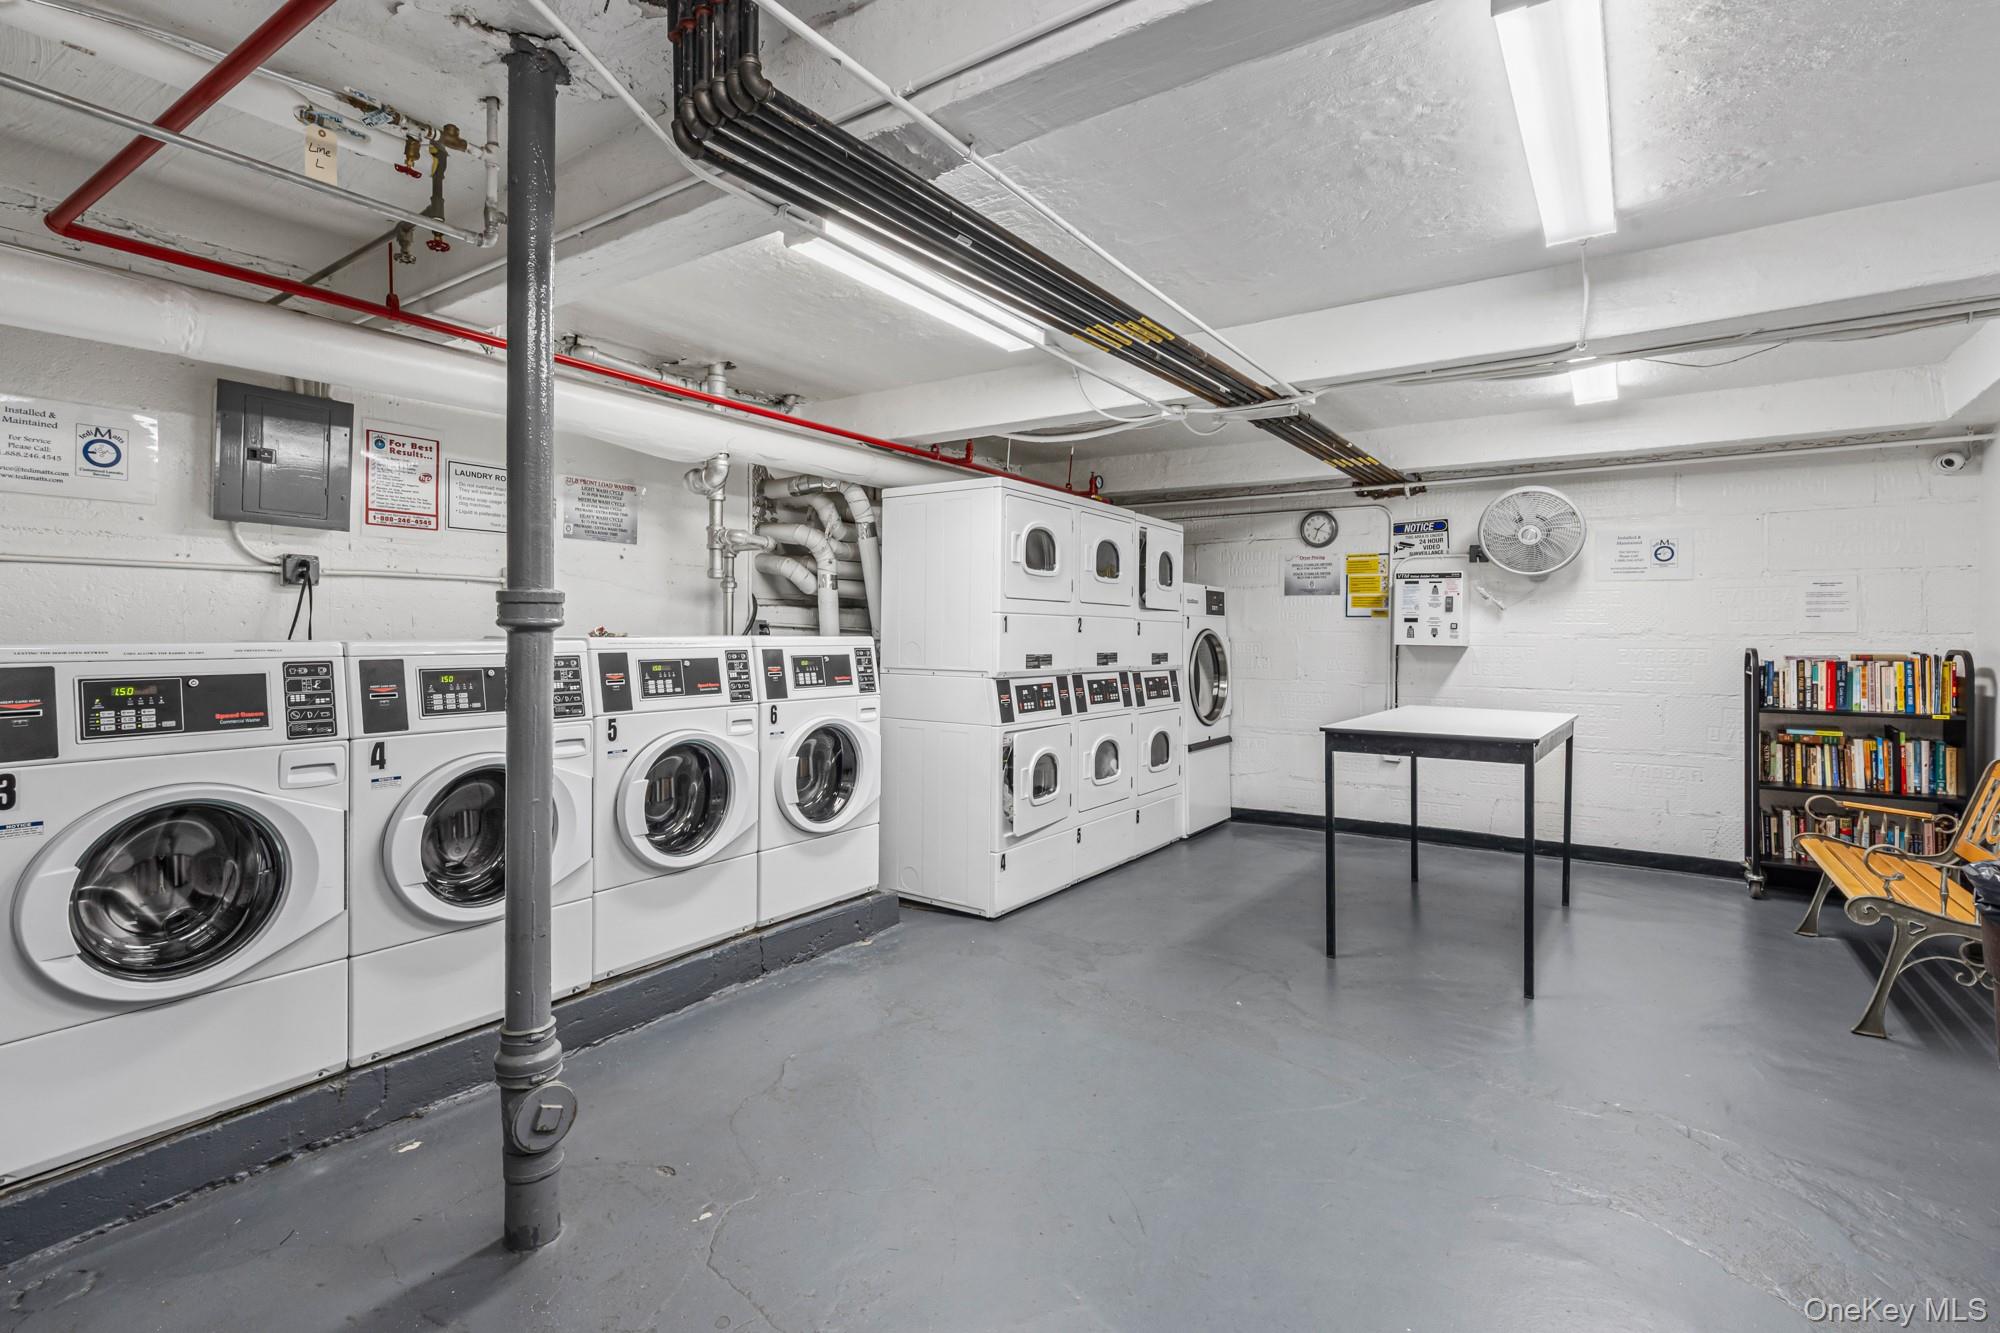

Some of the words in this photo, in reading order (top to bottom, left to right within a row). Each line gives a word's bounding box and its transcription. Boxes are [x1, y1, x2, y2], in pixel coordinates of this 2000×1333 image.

[308, 142, 331, 157] Line
[316, 158, 325, 169] L
[4, 406, 46, 418] Installed
[2, 416, 58, 429] Maintained
[8, 442, 32, 450] Please
[23, 435, 52, 444] Service
[389, 440, 406, 448] For
[411, 443, 432, 452] Best
[389, 447, 432, 460] Results...
[455, 469, 493, 480] LAUNDRY
[1404, 522, 1434, 532] NOTICE
[1003, 616, 1007, 632] 1
[1078, 618, 1082, 632] 2
[1137, 622, 1140, 635] 3
[770, 705, 777, 724] 6
[608, 719, 617, 742] 5
[371, 742, 386, 769] 4
[0, 773, 16, 810] 3
[1077, 828, 1081, 843] 5
[1000, 854, 1006, 870] 4
